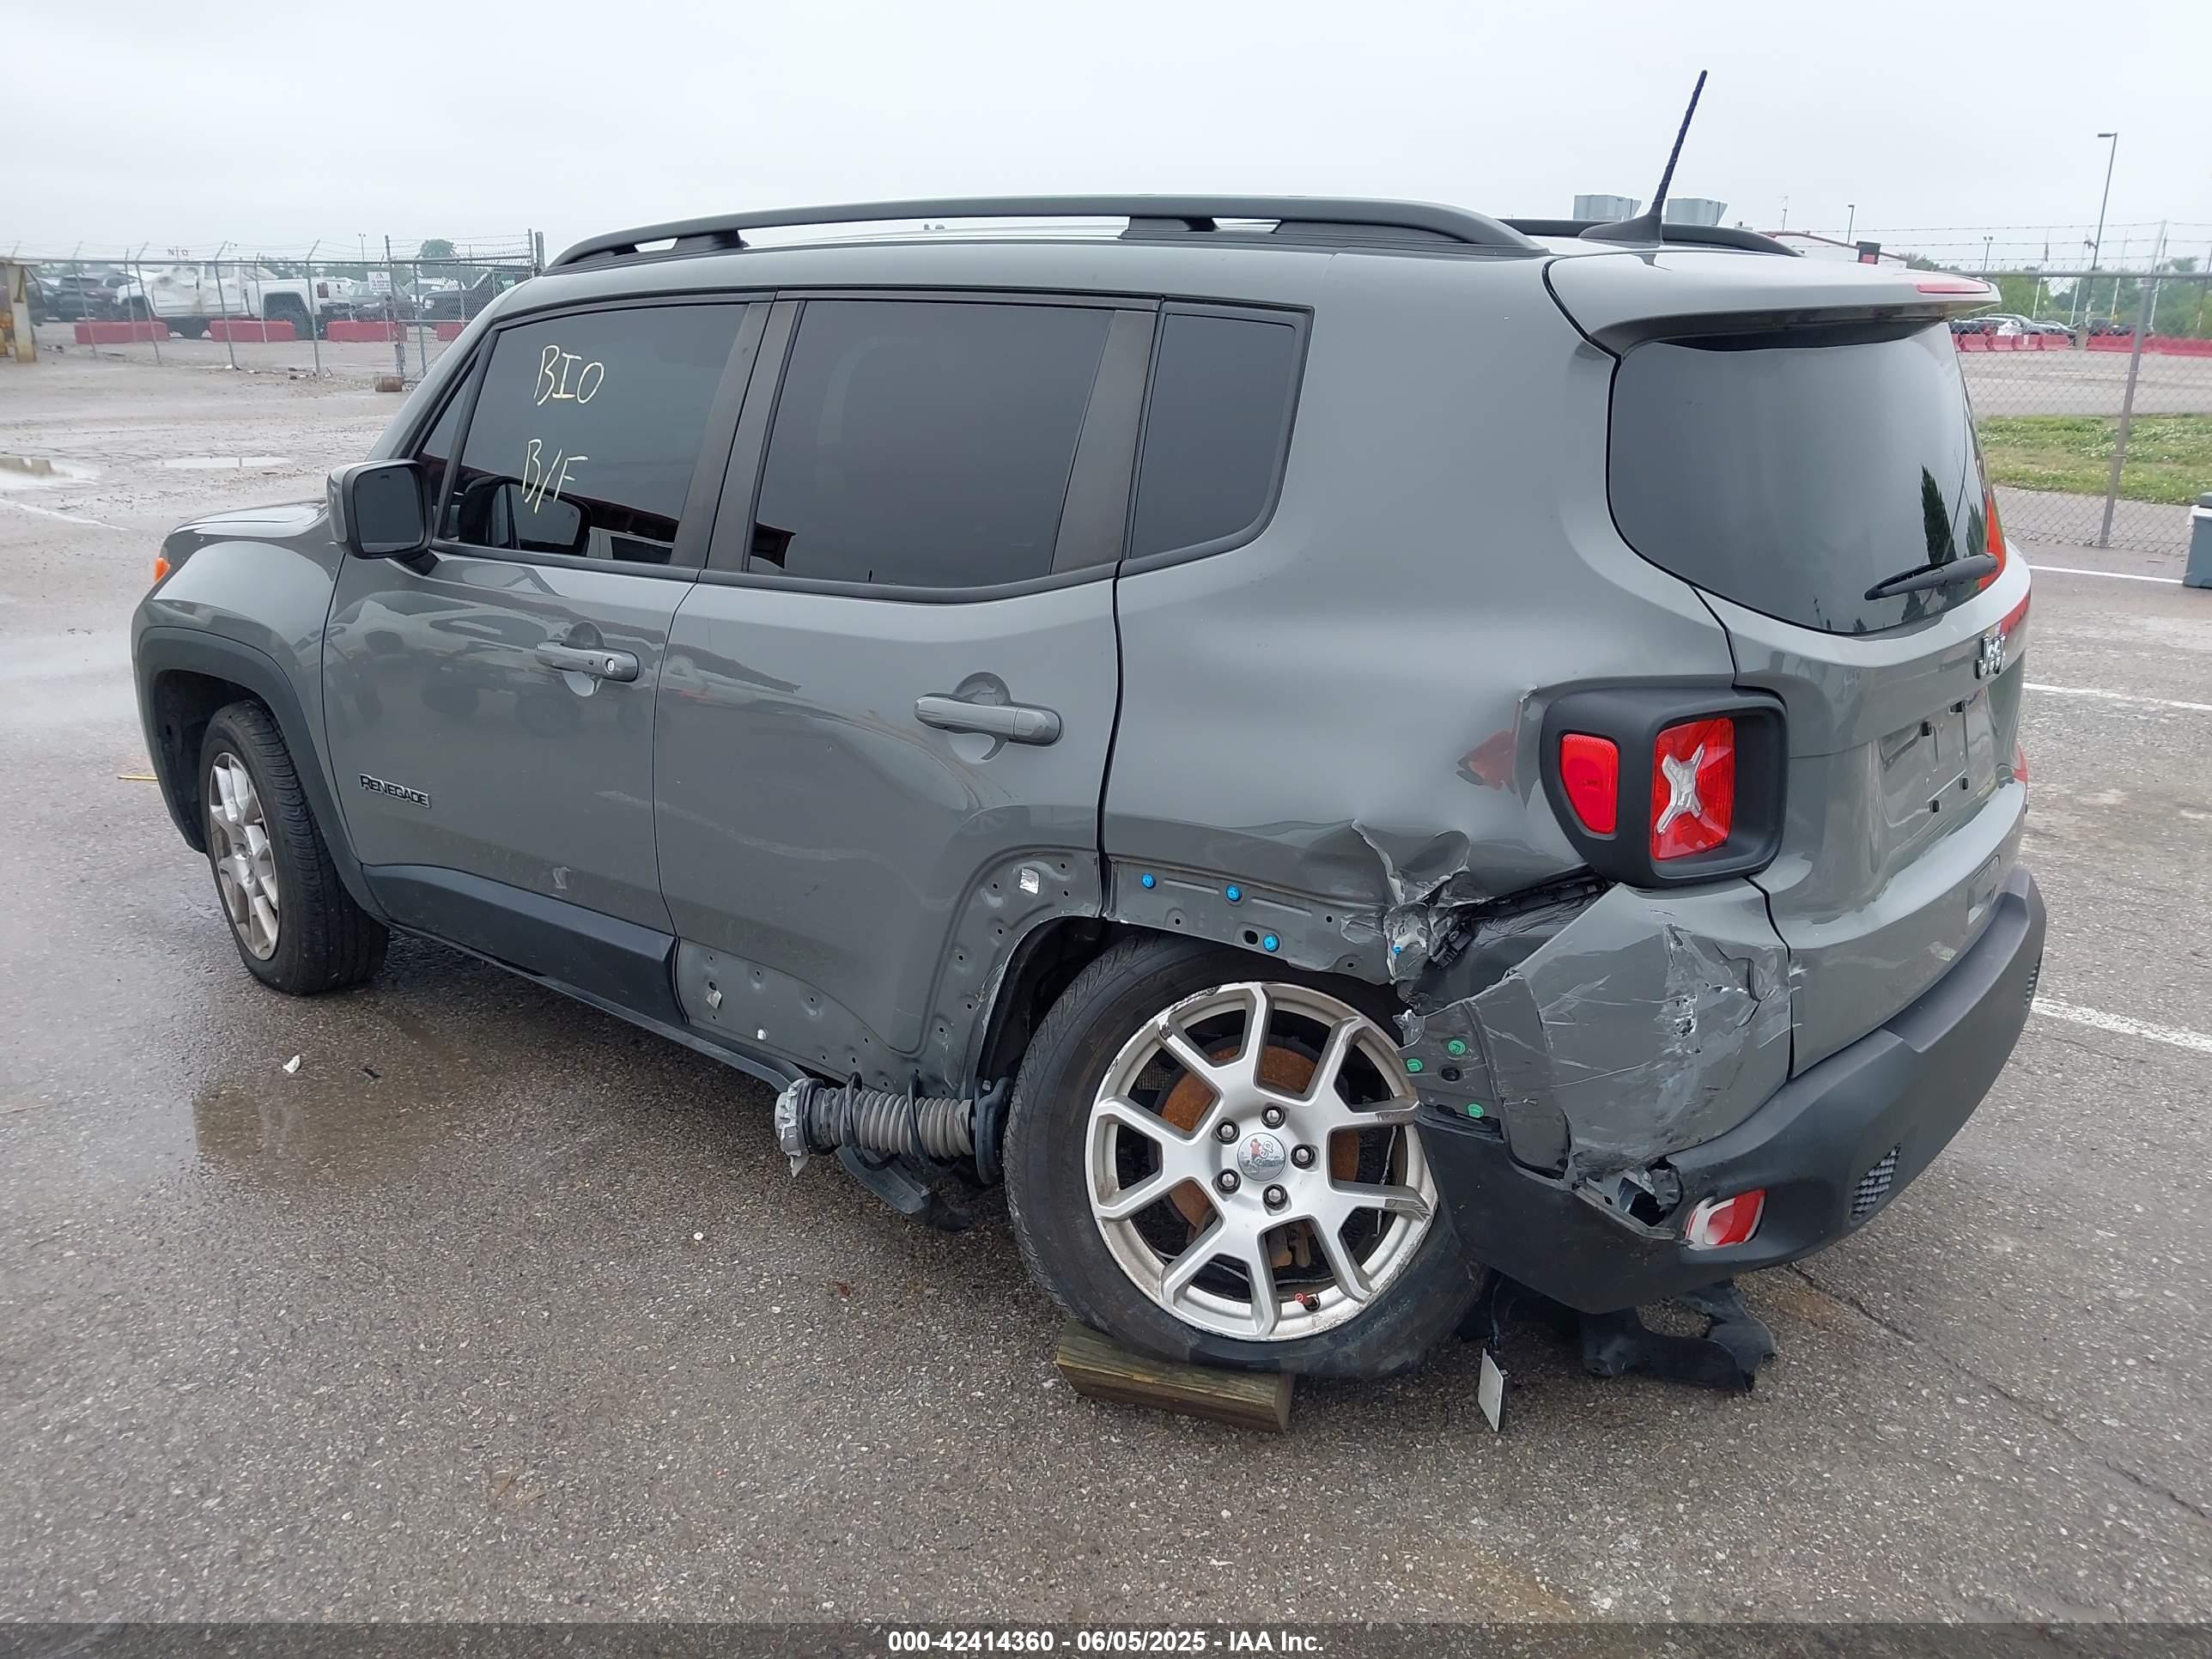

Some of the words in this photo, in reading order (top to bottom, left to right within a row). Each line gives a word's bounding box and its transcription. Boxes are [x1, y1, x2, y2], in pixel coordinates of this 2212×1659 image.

[533, 343, 605, 406] BIO
[521, 438, 589, 514] B/F
[359, 773, 430, 808] RENEGADE
